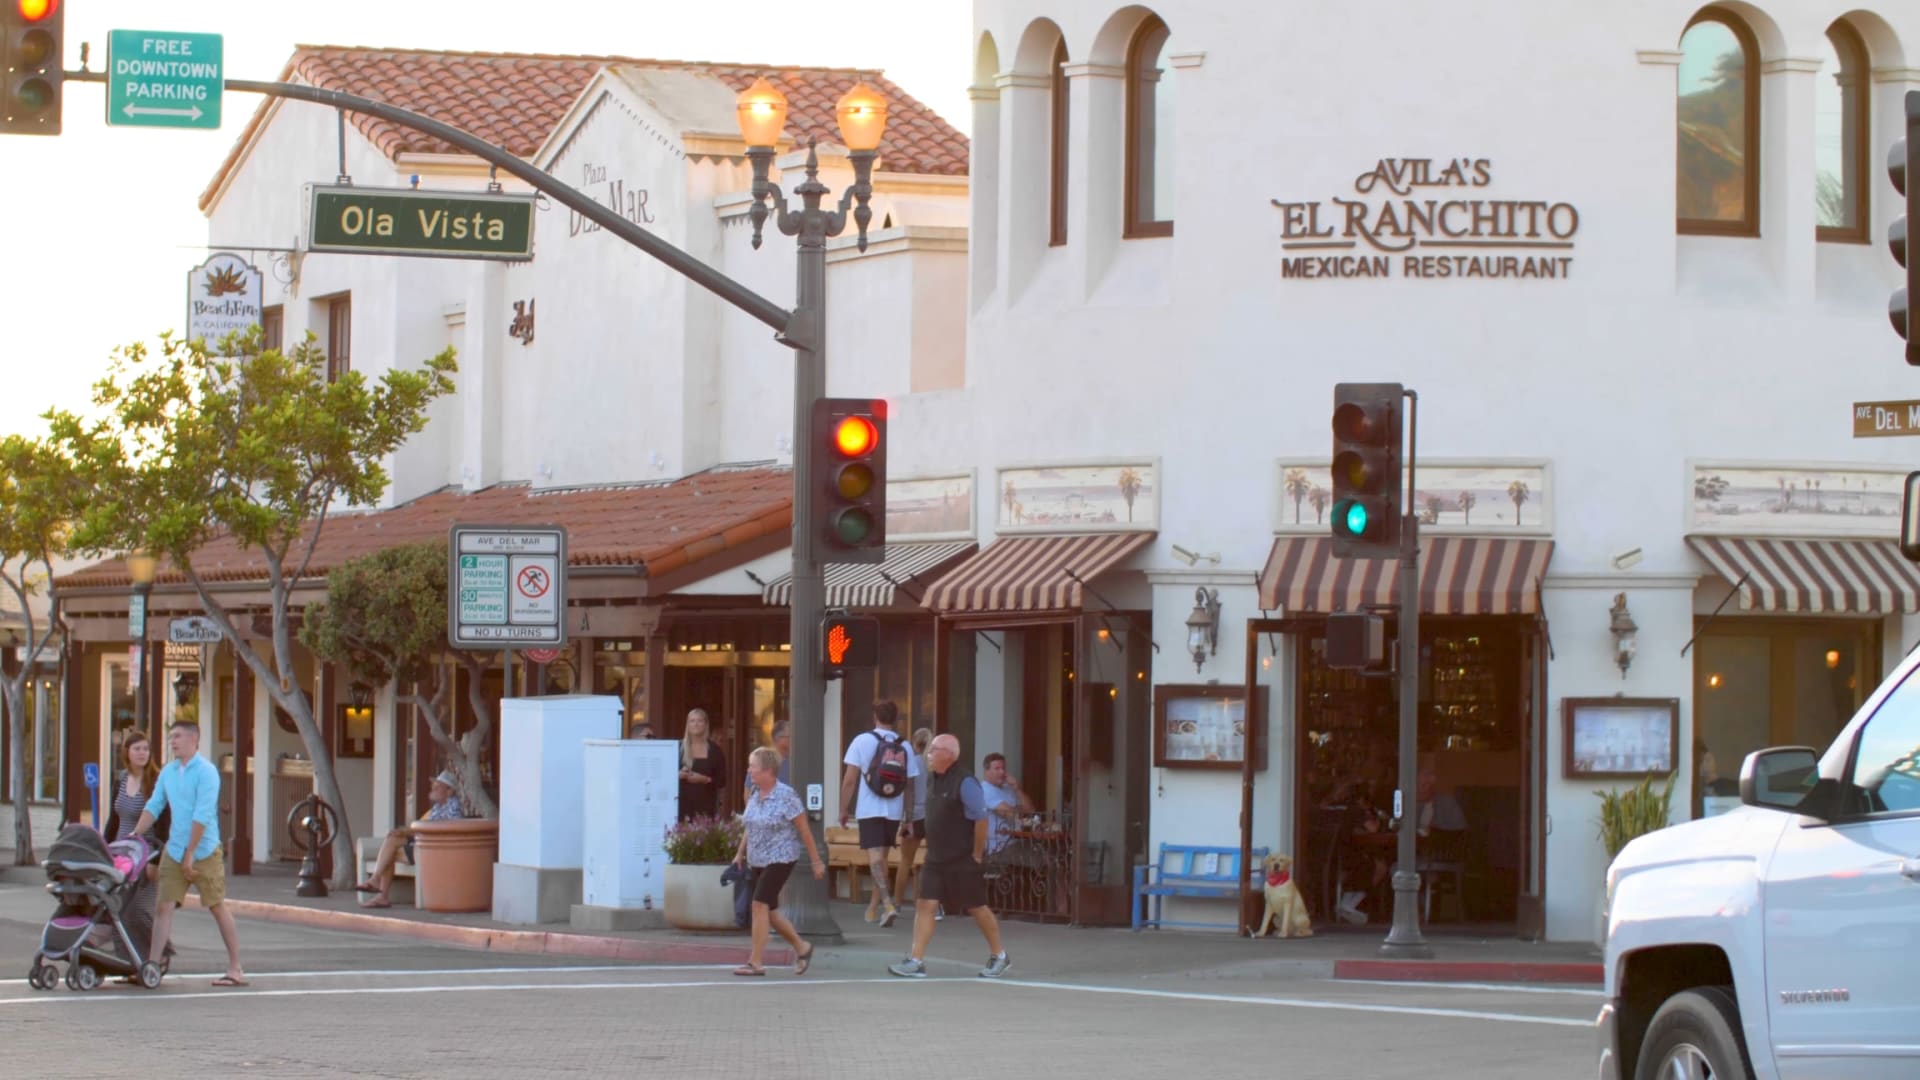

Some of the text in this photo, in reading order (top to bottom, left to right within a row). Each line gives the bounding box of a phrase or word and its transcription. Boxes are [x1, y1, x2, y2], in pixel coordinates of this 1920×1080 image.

[142, 38, 193, 56] FREE
[116, 59, 218, 79] DOWNTOWN
[125, 81, 208, 101] PARKING
[1355, 158, 1491, 196] AVILA'S
[341, 205, 505, 241] Ola Vista
[1271, 196, 1579, 253] EL RANCHITO
[1281, 255, 1574, 279] MEXICAN RESTAURANT
[1875, 407, 1902, 430] DEL
[478, 537, 541, 545] AVE DEL MAR
[465, 557, 503, 568] 2 HOUR
[464, 570, 503, 578] PARKING
[462, 591, 476, 601] 30
[464, 603, 503, 612] PARKING
[475, 628, 542, 637] NO U TURNS
[165, 646, 201, 655] DENTIS
